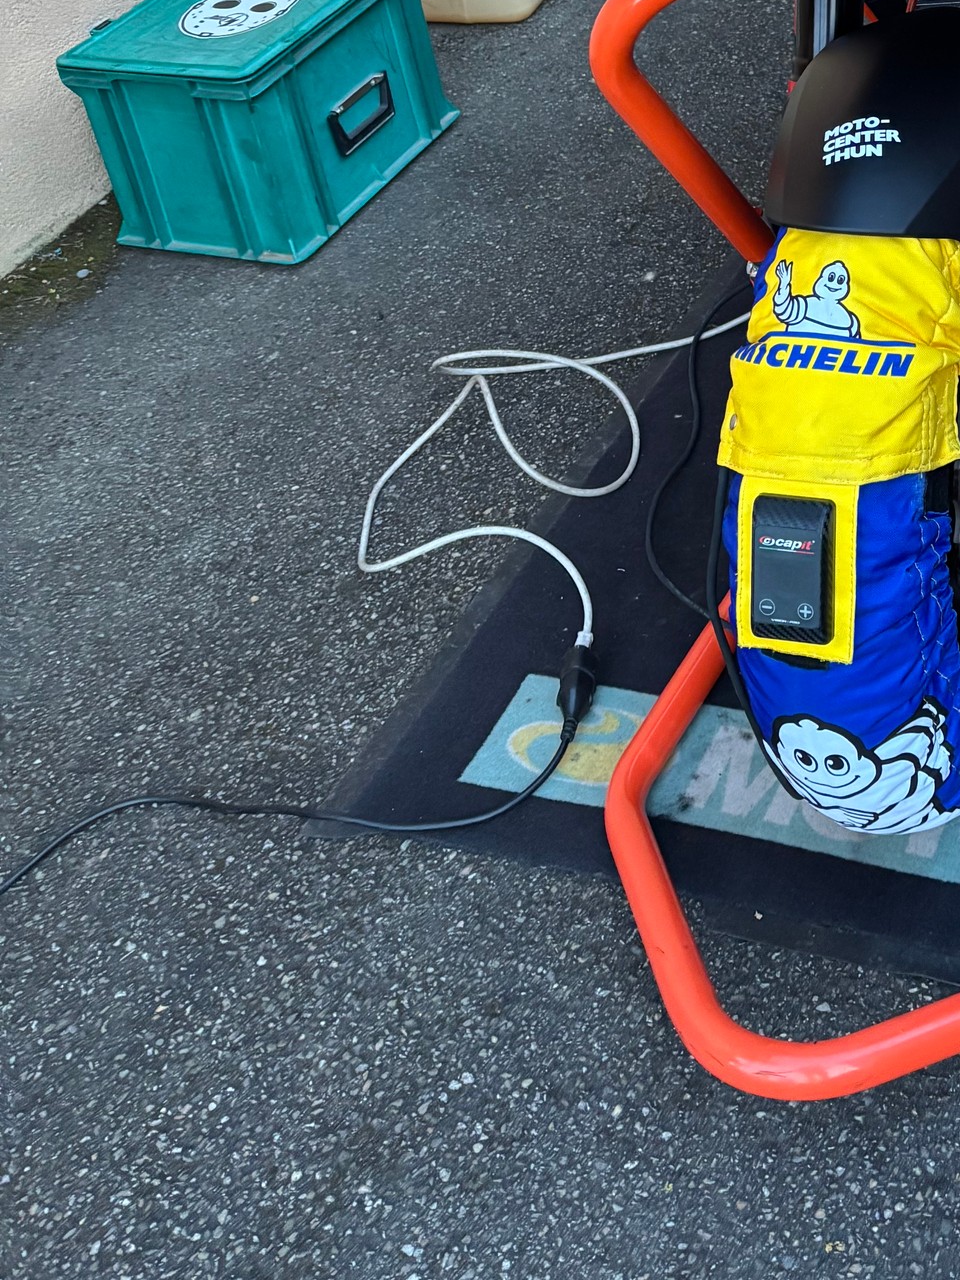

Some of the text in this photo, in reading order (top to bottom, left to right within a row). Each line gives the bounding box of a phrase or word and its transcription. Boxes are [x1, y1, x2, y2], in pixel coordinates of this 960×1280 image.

[823, 129, 901, 153] CENTER
[824, 116, 890, 142] MOTO-
[822, 144, 883, 166] THUN
[734, 343, 915, 377] MICHELIN
